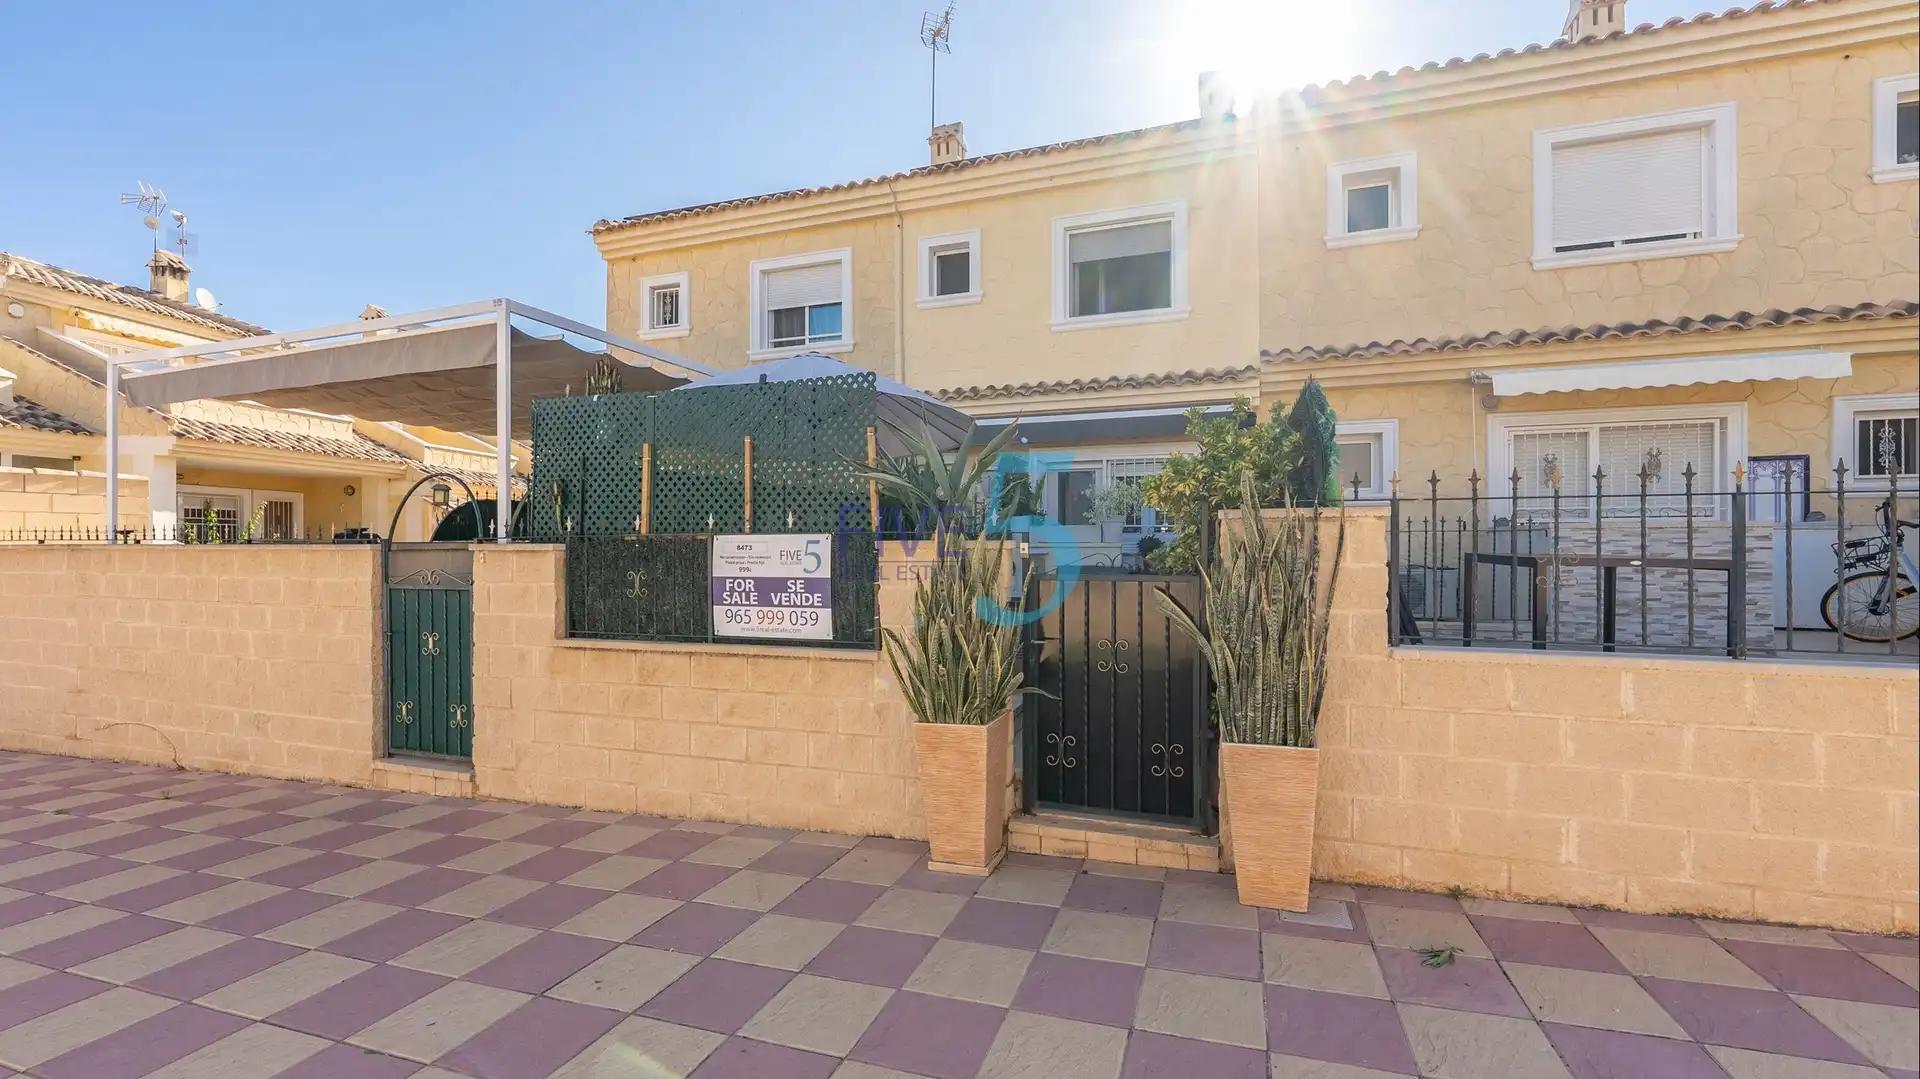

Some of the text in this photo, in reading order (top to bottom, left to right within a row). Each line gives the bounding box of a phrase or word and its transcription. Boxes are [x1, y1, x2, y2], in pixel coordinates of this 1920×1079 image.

[780, 550, 802, 561] FIVE
[803, 540, 822, 573] 5
[725, 579, 805, 592] FOR SE
[723, 592, 823, 606] SALE VENDE
[725, 609, 819, 626] 965 999 059
